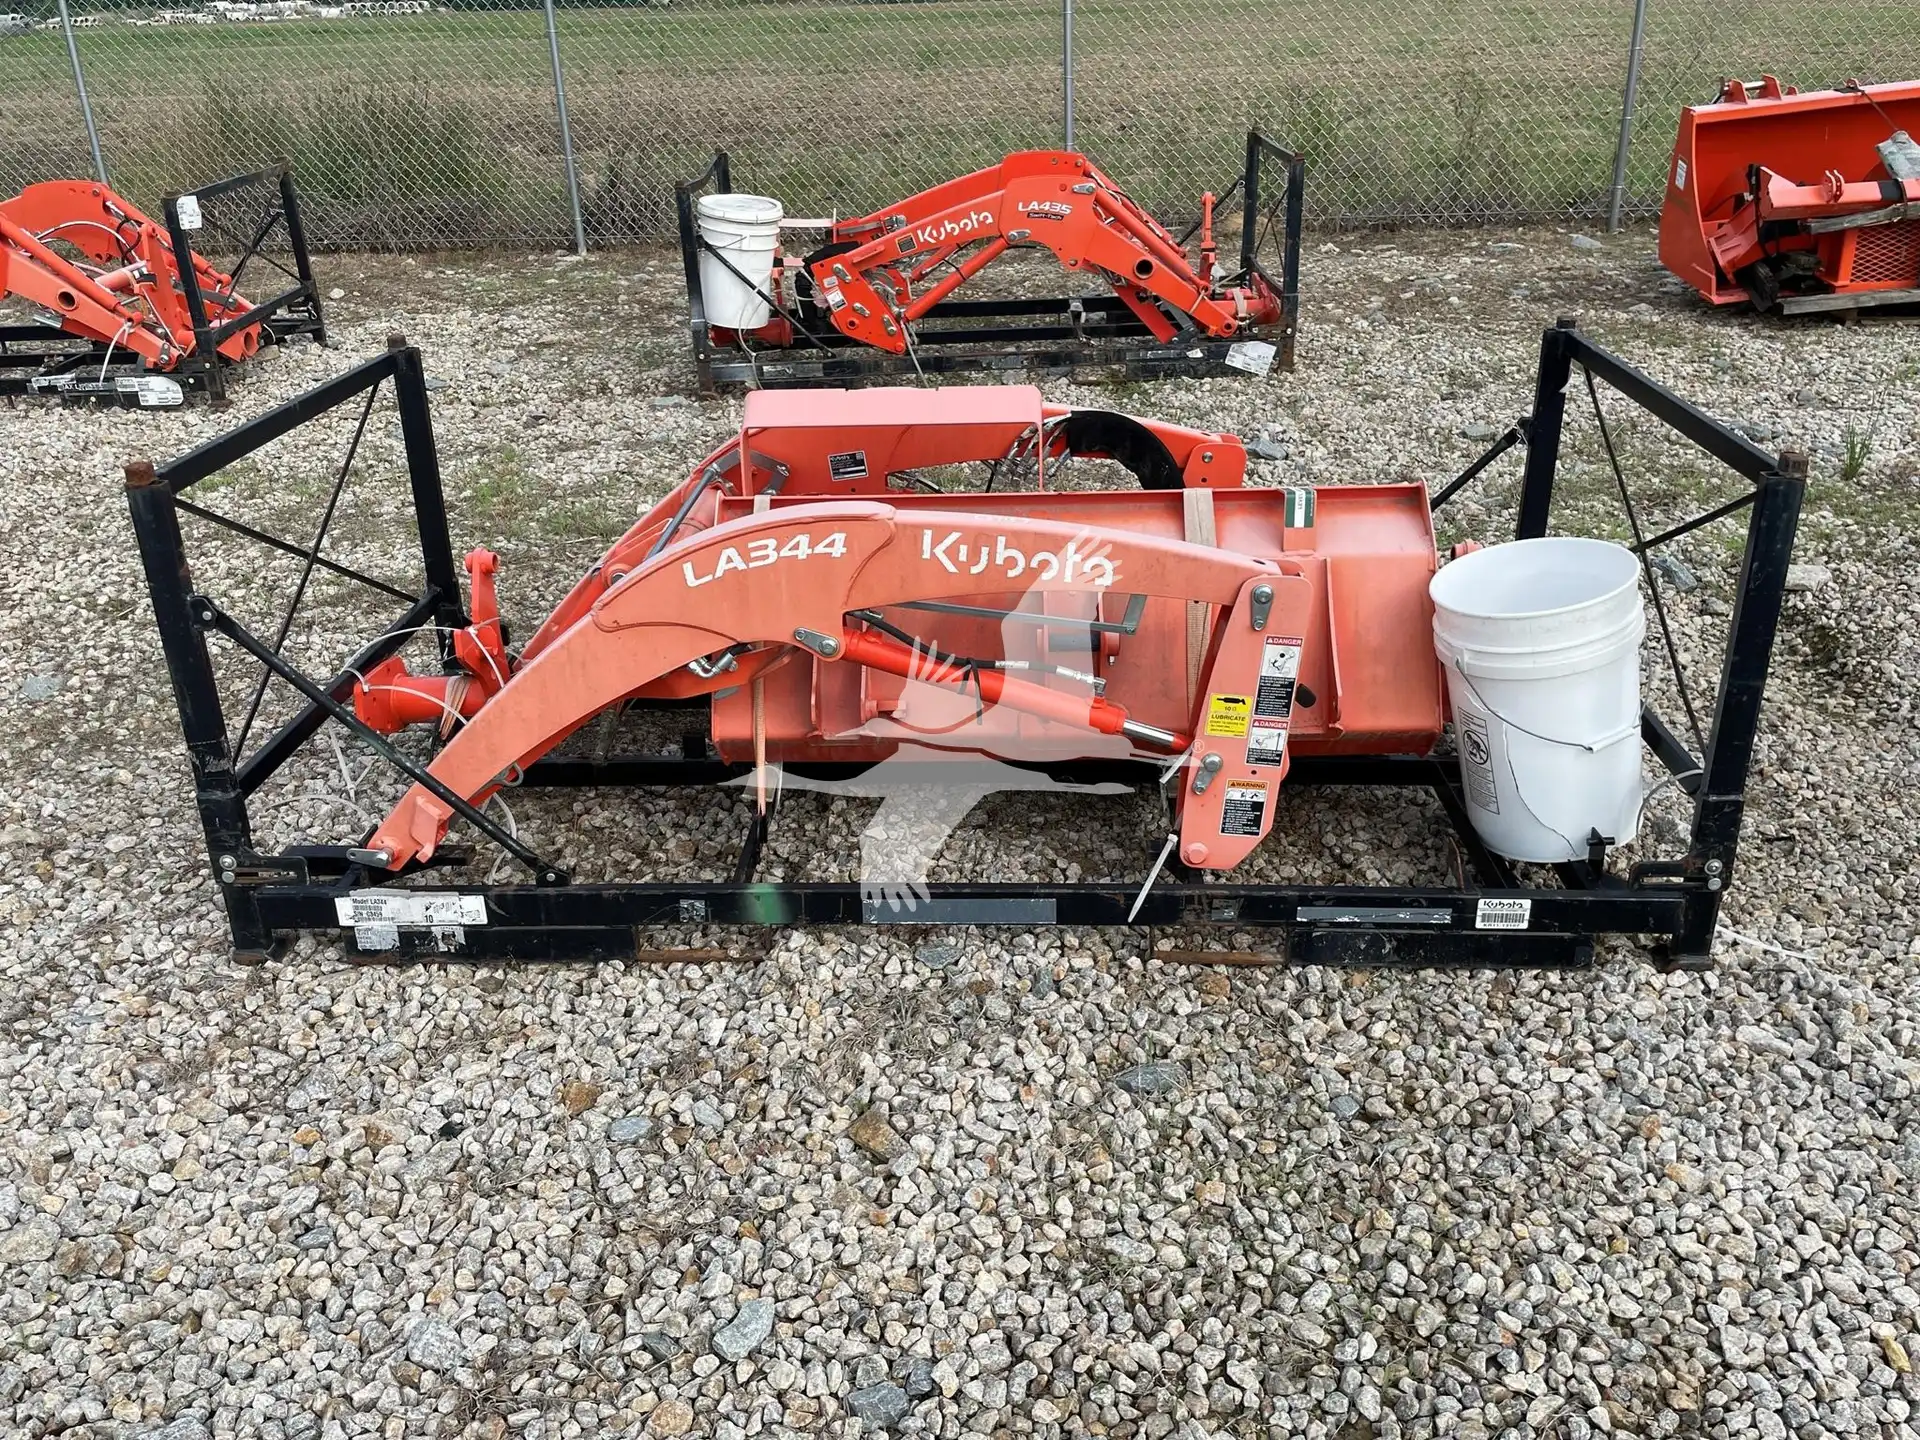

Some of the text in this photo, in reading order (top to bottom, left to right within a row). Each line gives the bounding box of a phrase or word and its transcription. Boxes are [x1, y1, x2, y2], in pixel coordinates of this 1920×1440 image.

[1018, 200, 1073, 215] LA435
[916, 210, 994, 244] Kubota
[682, 531, 848, 588] LA344
[921, 528, 1115, 587] Kubota
[1273, 638, 1302, 646] DANGER
[1211, 713, 1247, 722] LUBRICATE
[1259, 720, 1287, 729] DANGER
[1483, 900, 1524, 909] Kubota
[424, 914, 434, 923] 10
